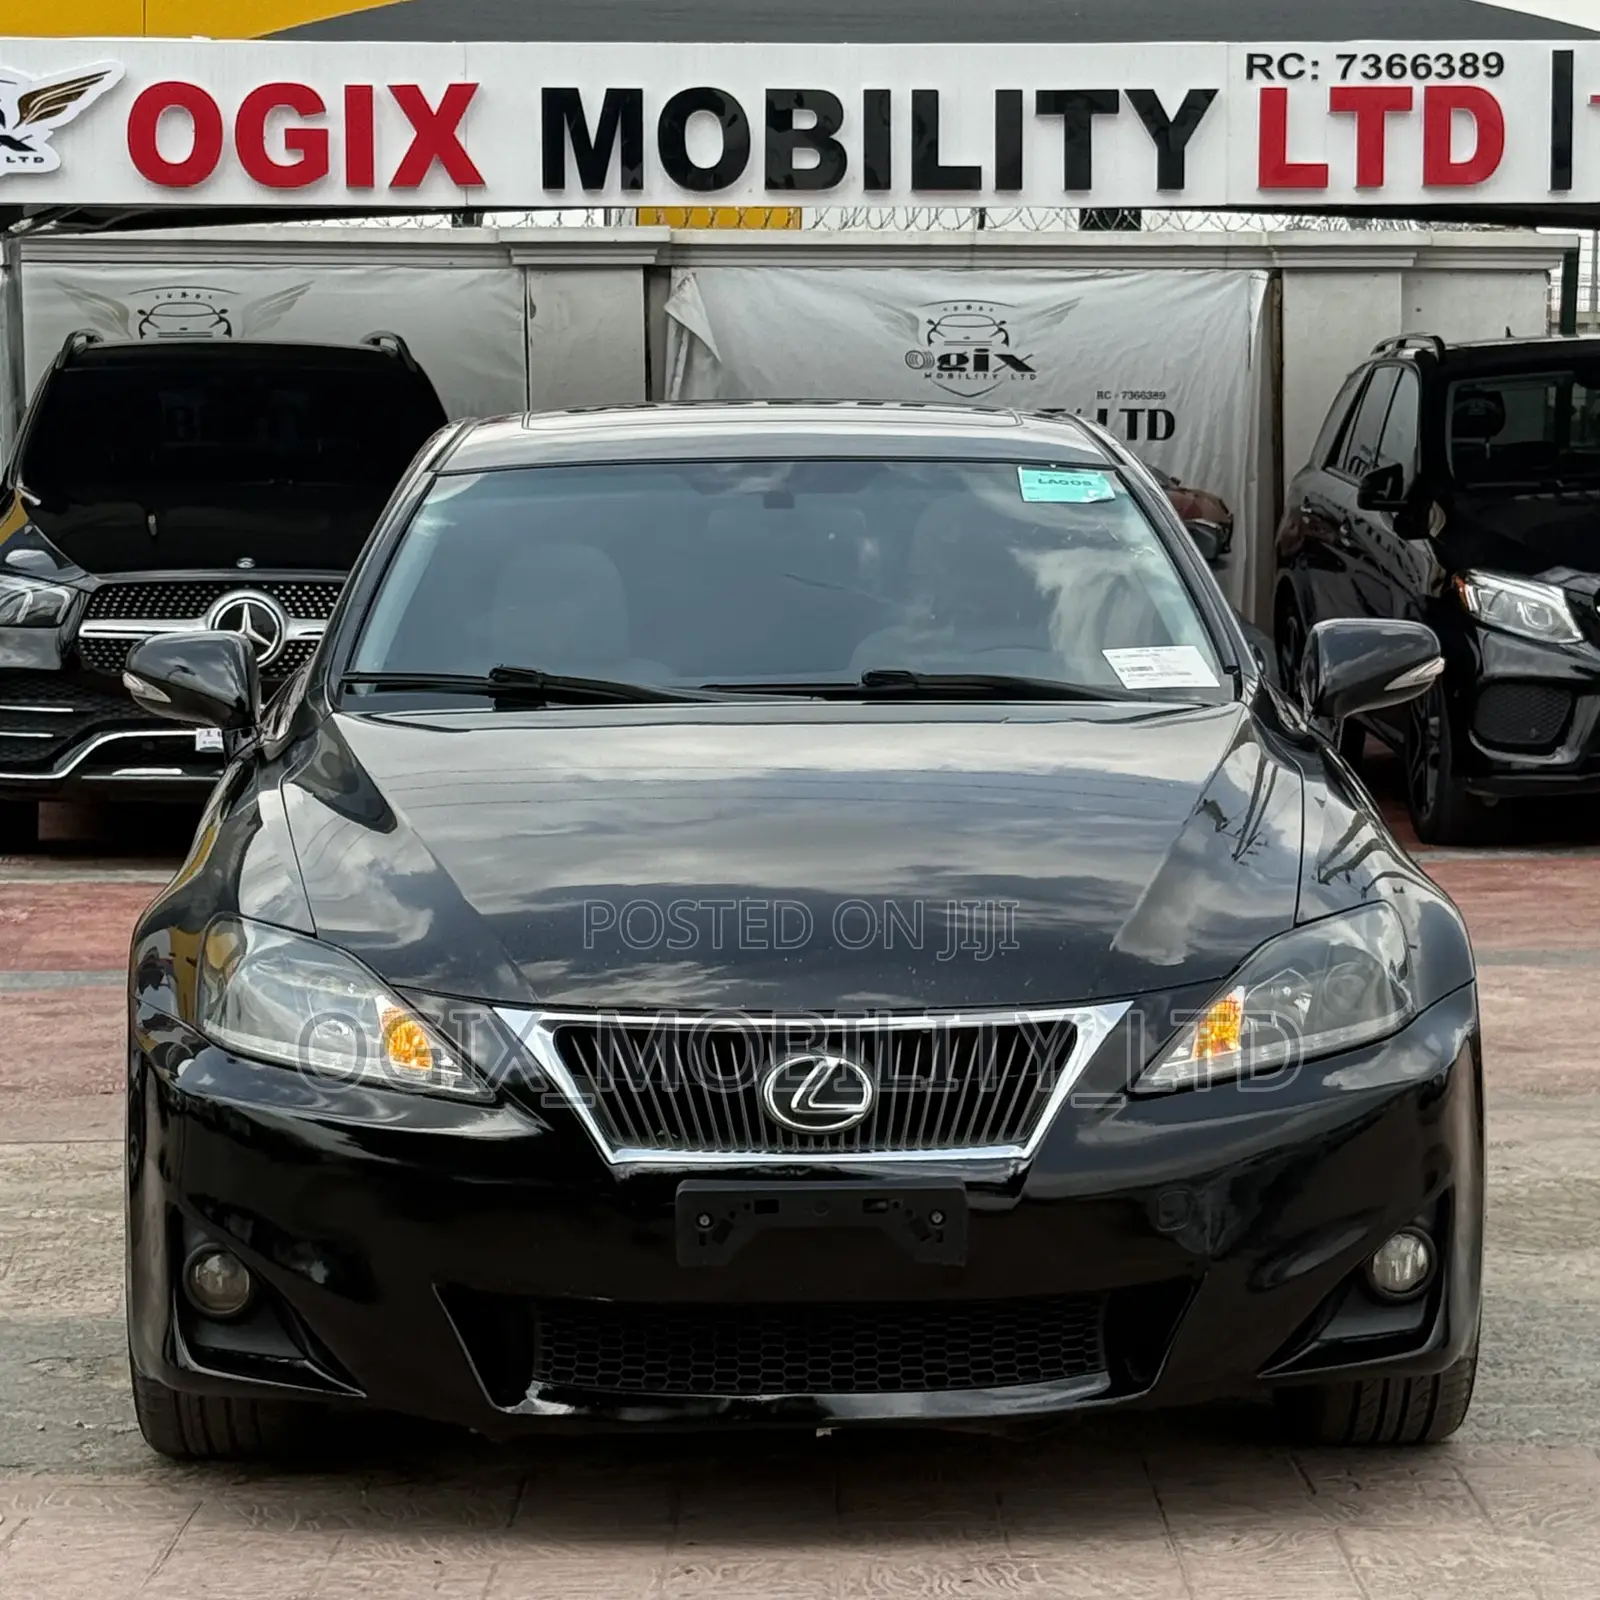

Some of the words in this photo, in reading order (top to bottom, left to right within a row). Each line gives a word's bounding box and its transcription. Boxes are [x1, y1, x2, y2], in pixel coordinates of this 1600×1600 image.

[1246, 53, 1319, 80] RC:
[1336, 52, 1505, 80] 7366389
[127, 81, 484, 188] OGIX
[541, 86, 1219, 191] MOBILITY
[1258, 86, 1506, 189] LTD
[6, 156, 45, 164] LTD
[924, 372, 998, 380] MOBILITY
